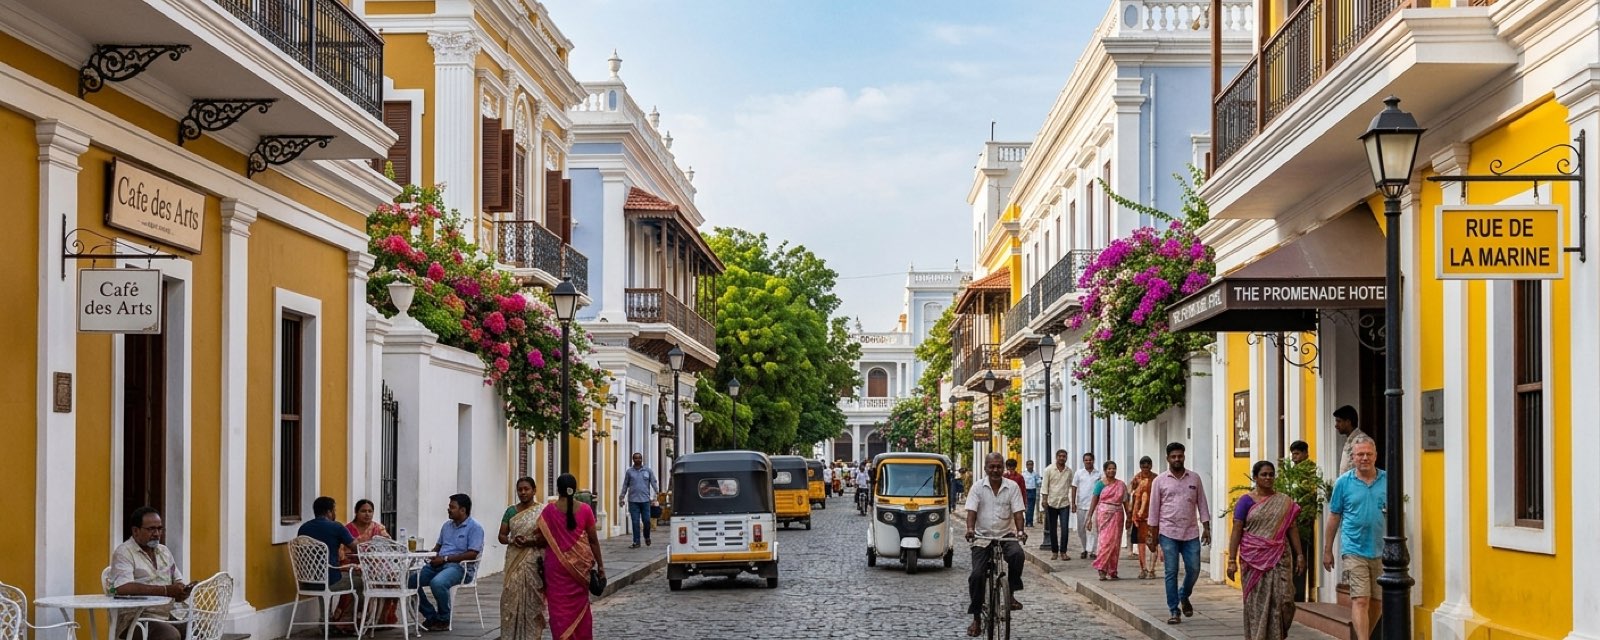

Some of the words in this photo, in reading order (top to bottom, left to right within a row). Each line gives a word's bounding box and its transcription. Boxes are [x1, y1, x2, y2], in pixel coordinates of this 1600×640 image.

[117, 176, 148, 213] Cafe
[151, 188, 171, 221] des
[173, 198, 199, 231] Arts
[1466, 218, 1503, 238] RUE
[1509, 218, 1534, 238] DE
[1450, 247, 1475, 267] LA
[1478, 247, 1550, 267] MARINE
[99, 281, 139, 297] Café
[1233, 286, 1260, 301] THE
[1263, 286, 1346, 301] PROMENADE
[84, 299, 112, 315] des
[116, 300, 153, 315] Arts
